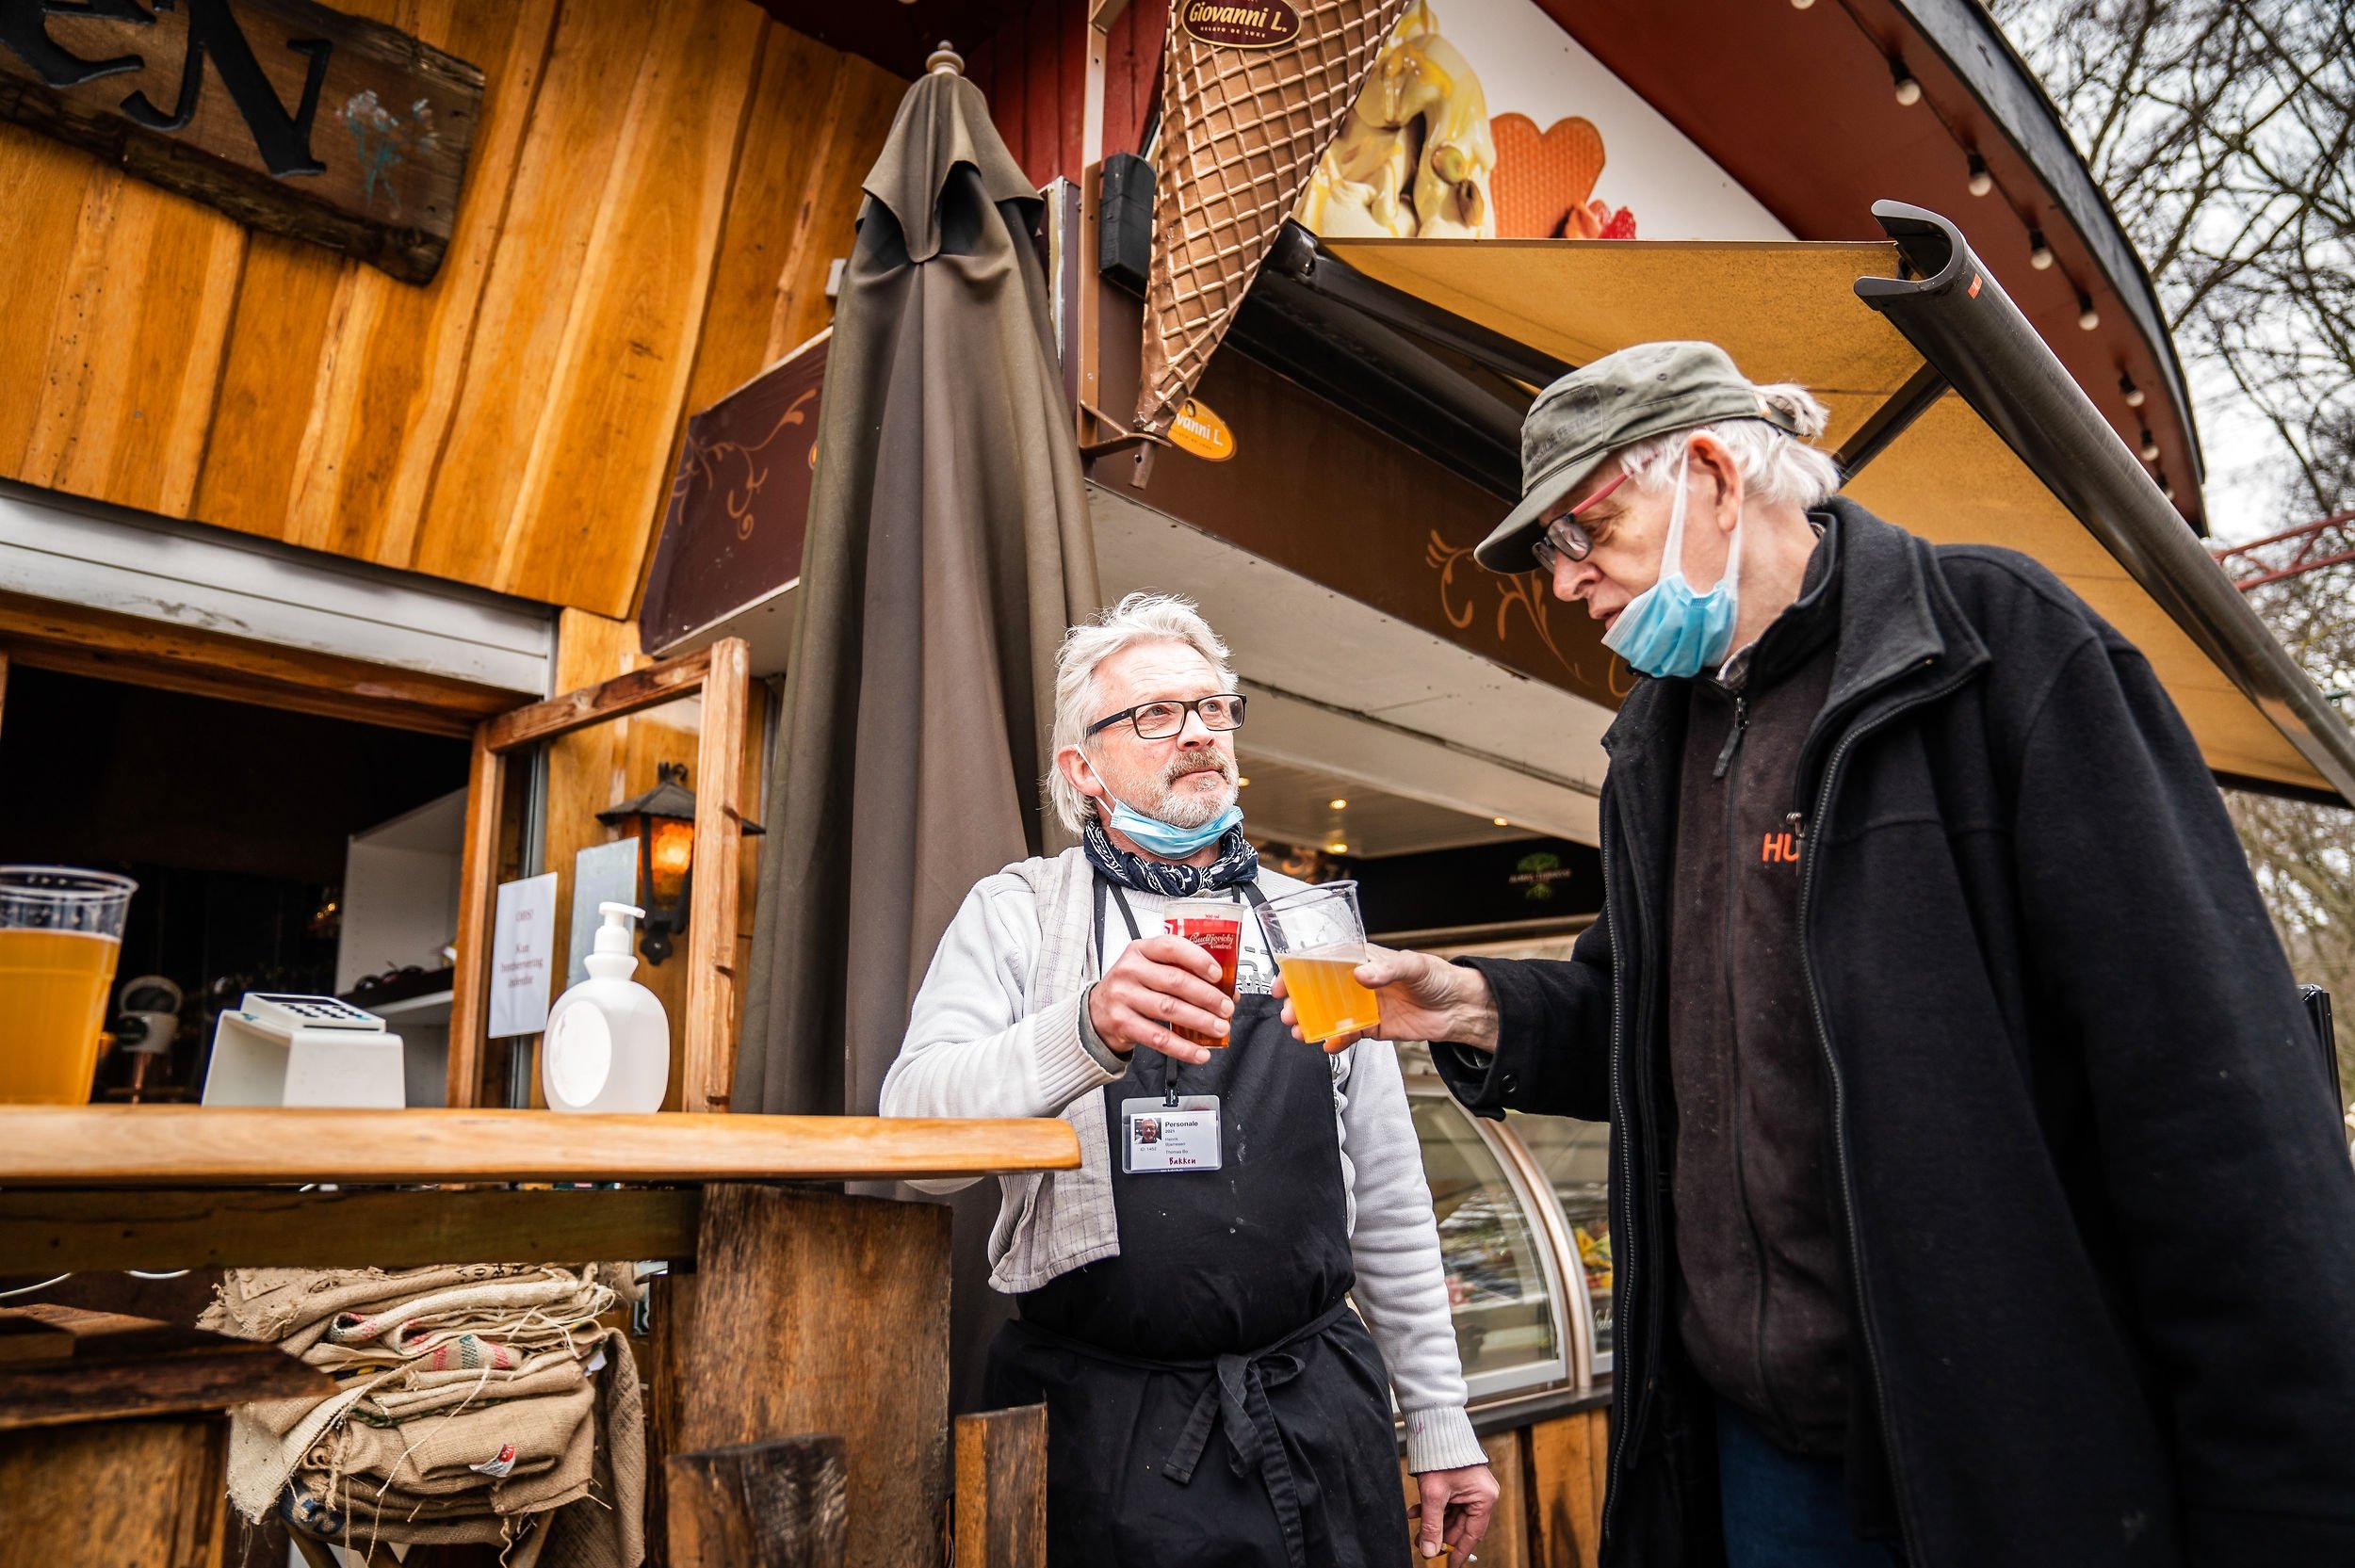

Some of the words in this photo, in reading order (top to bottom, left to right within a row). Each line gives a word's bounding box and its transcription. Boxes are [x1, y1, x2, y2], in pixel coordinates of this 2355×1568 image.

[1189, 2, 1269, 28] Giovanni
[1271, 10, 1288, 32] L.
[1175, 412, 1210, 440] vanni
[1169, 1156, 1196, 1166] Bakken
